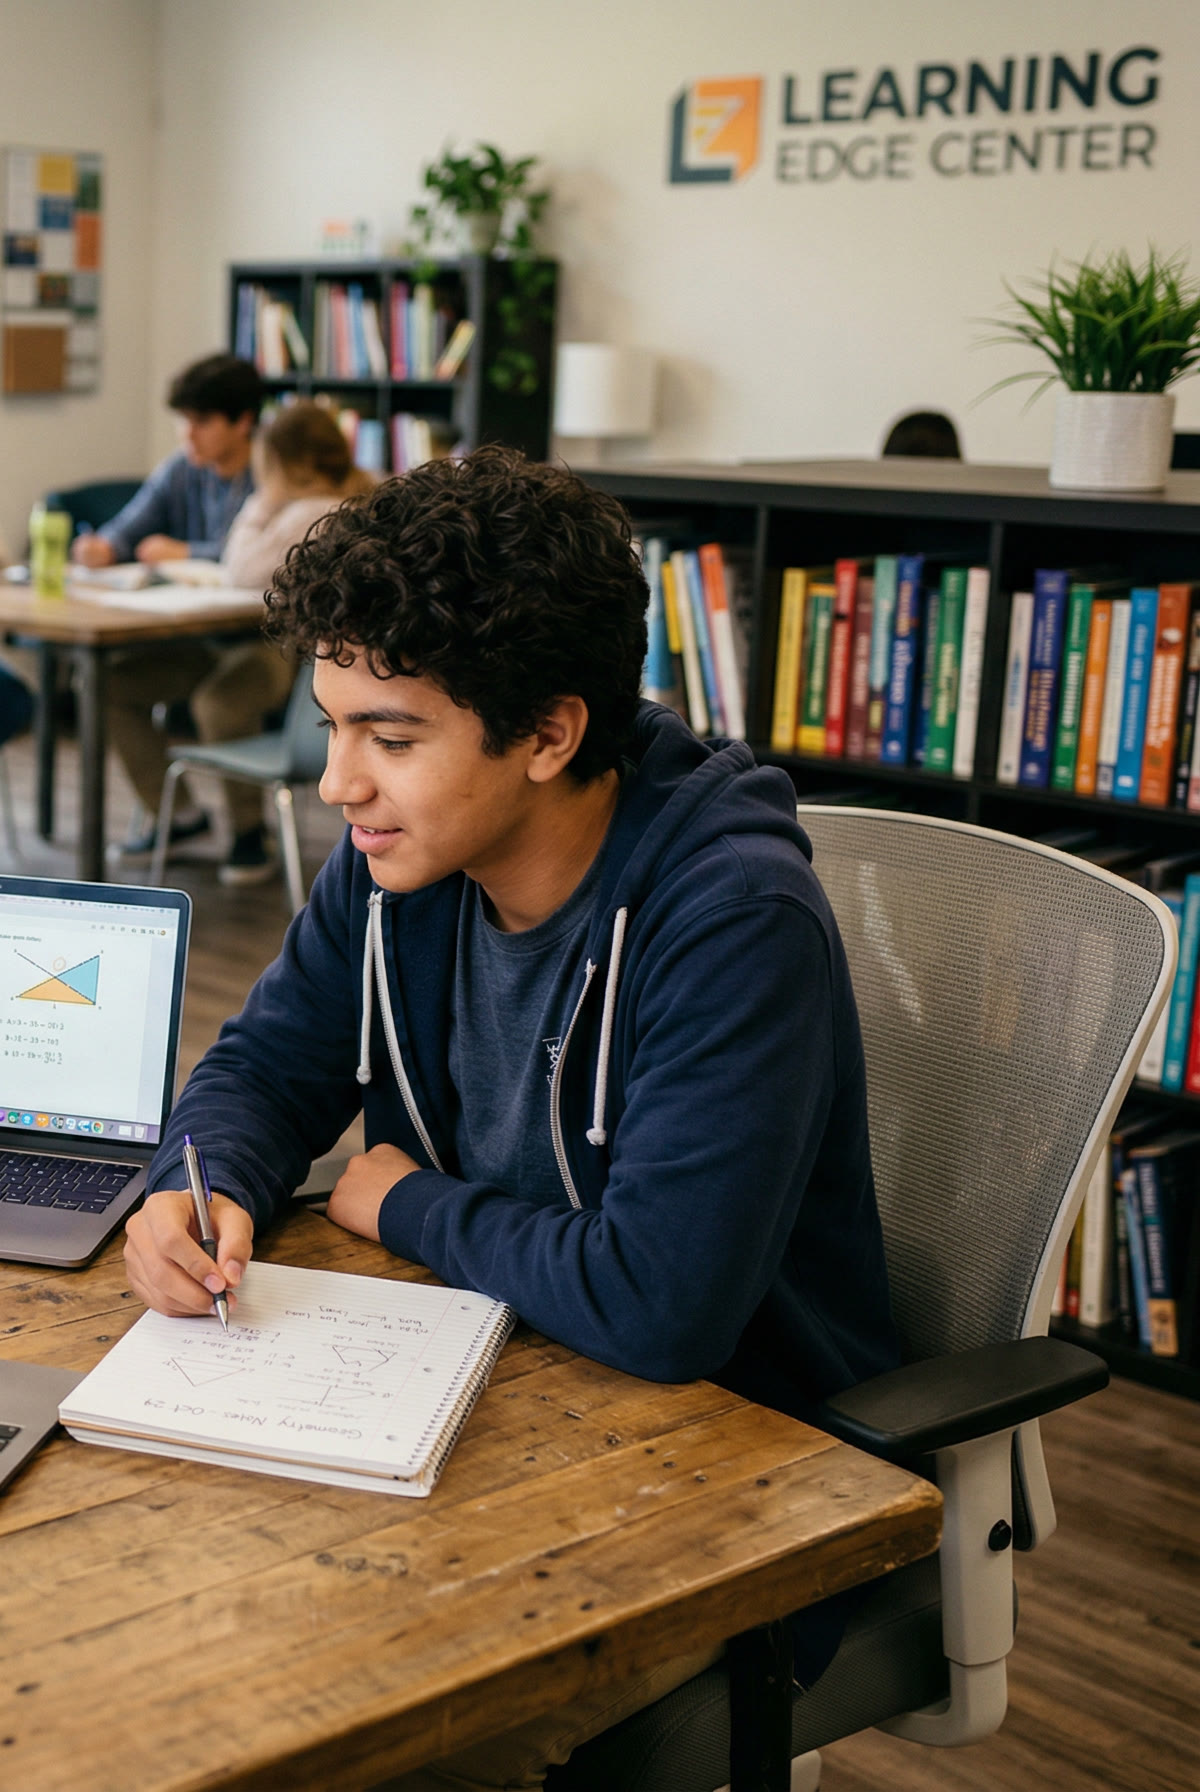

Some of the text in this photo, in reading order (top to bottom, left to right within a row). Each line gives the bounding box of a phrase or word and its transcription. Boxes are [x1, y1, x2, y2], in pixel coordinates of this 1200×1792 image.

[781, 43, 1162, 125] LEARNING
[774, 122, 1158, 184] EDGE CENTER
[173, 1404, 205, 1416] Oct
[223, 1410, 268, 1427] Notes
[278, 1415, 363, 1440] Geometry
